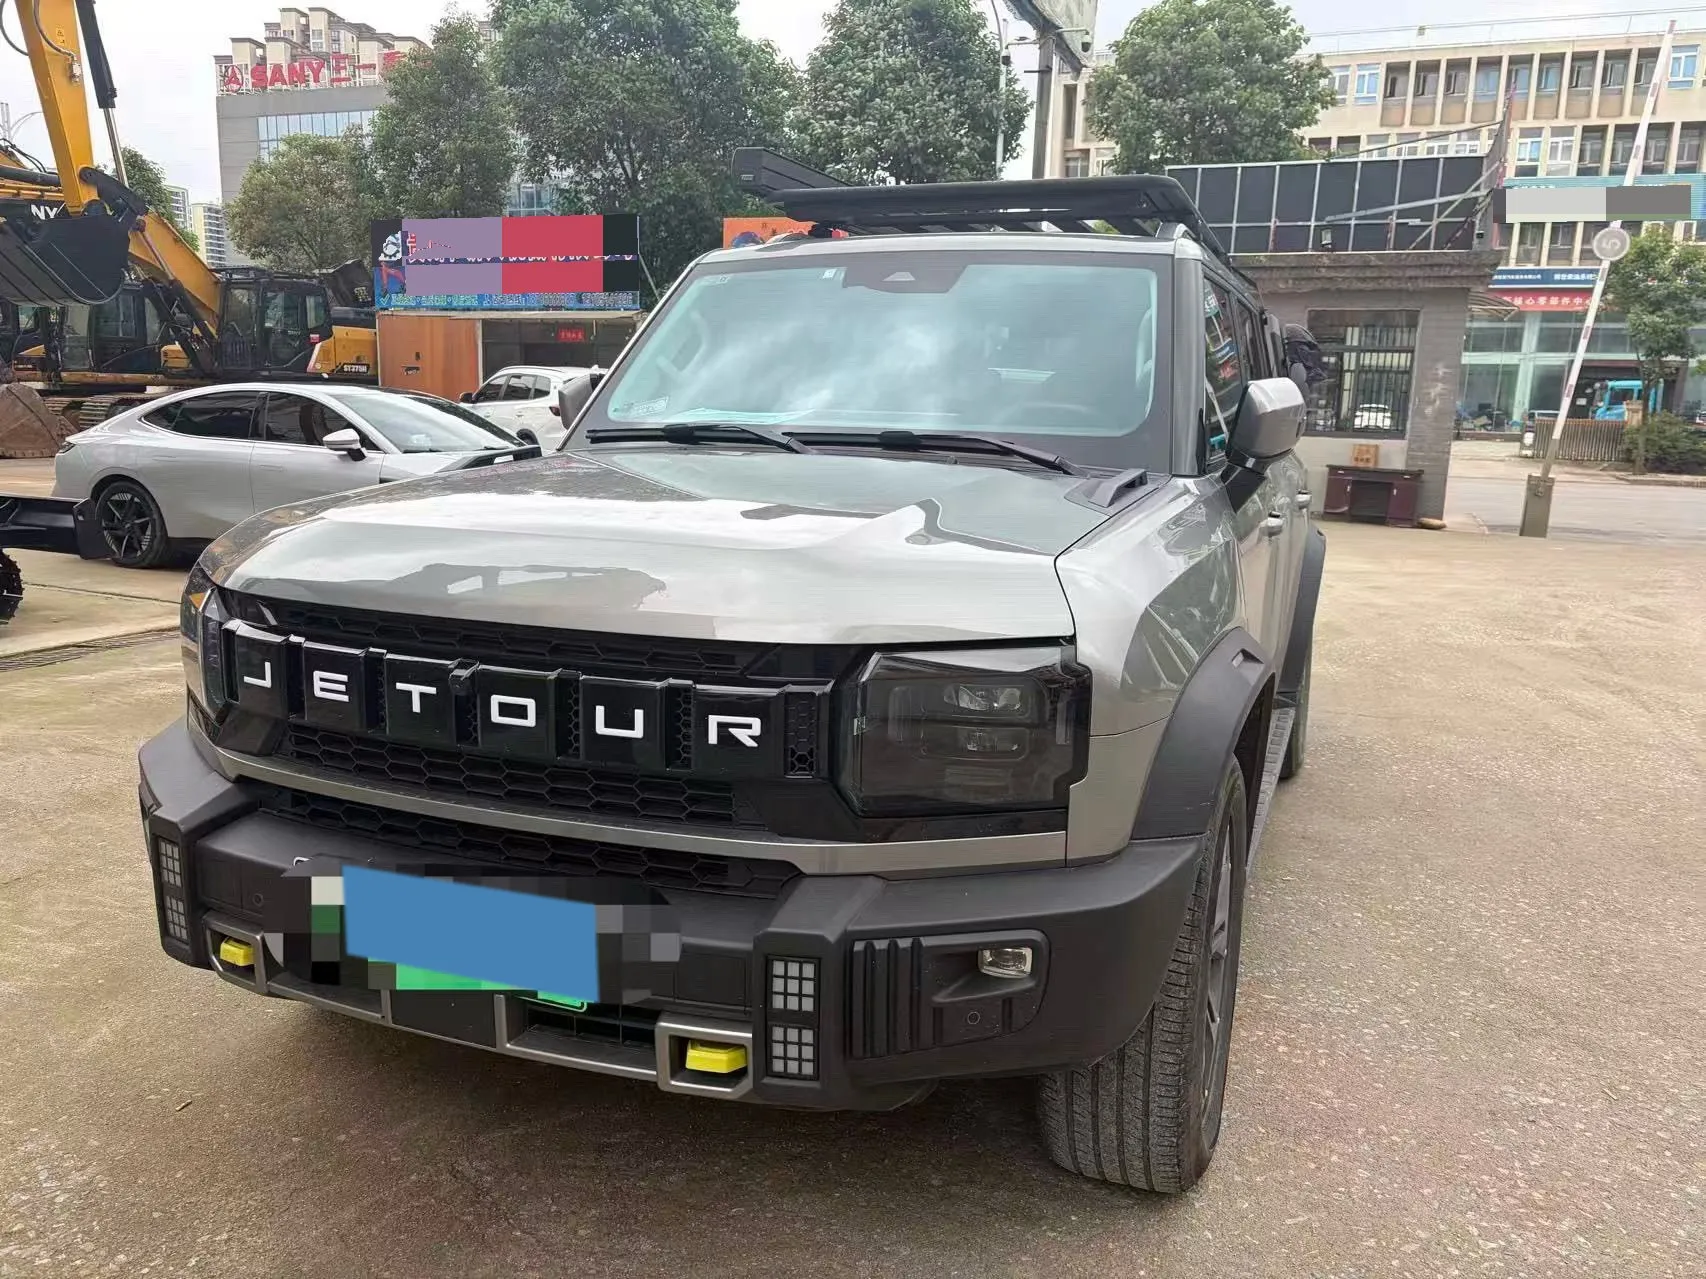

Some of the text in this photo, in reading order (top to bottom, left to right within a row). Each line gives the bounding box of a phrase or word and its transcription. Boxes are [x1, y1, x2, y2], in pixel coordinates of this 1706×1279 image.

[250, 57, 325, 88] SANY
[30, 204, 58, 220] NY
[243, 661, 762, 748] JETOUR
